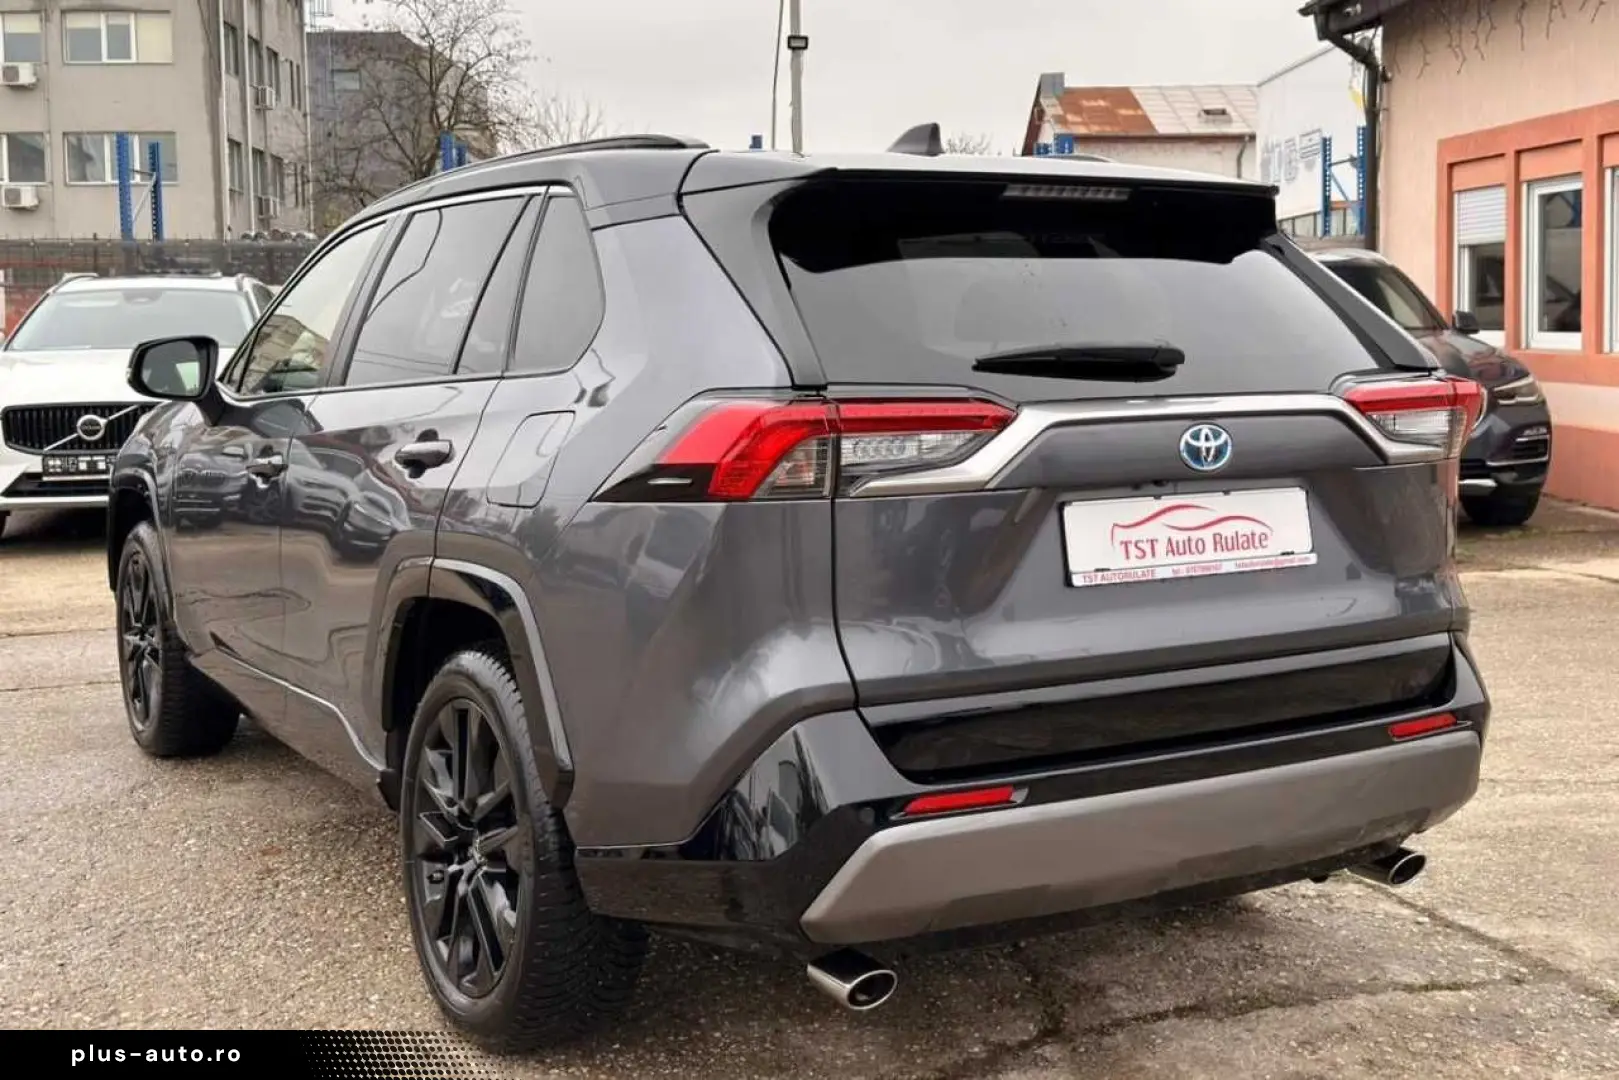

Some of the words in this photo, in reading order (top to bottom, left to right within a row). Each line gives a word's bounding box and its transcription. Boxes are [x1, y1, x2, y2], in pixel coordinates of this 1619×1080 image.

[1120, 539, 1159, 560] TST
[1165, 535, 1206, 558] Auto
[1213, 530, 1269, 553] Rulate
[1082, 573, 1098, 584] TST
